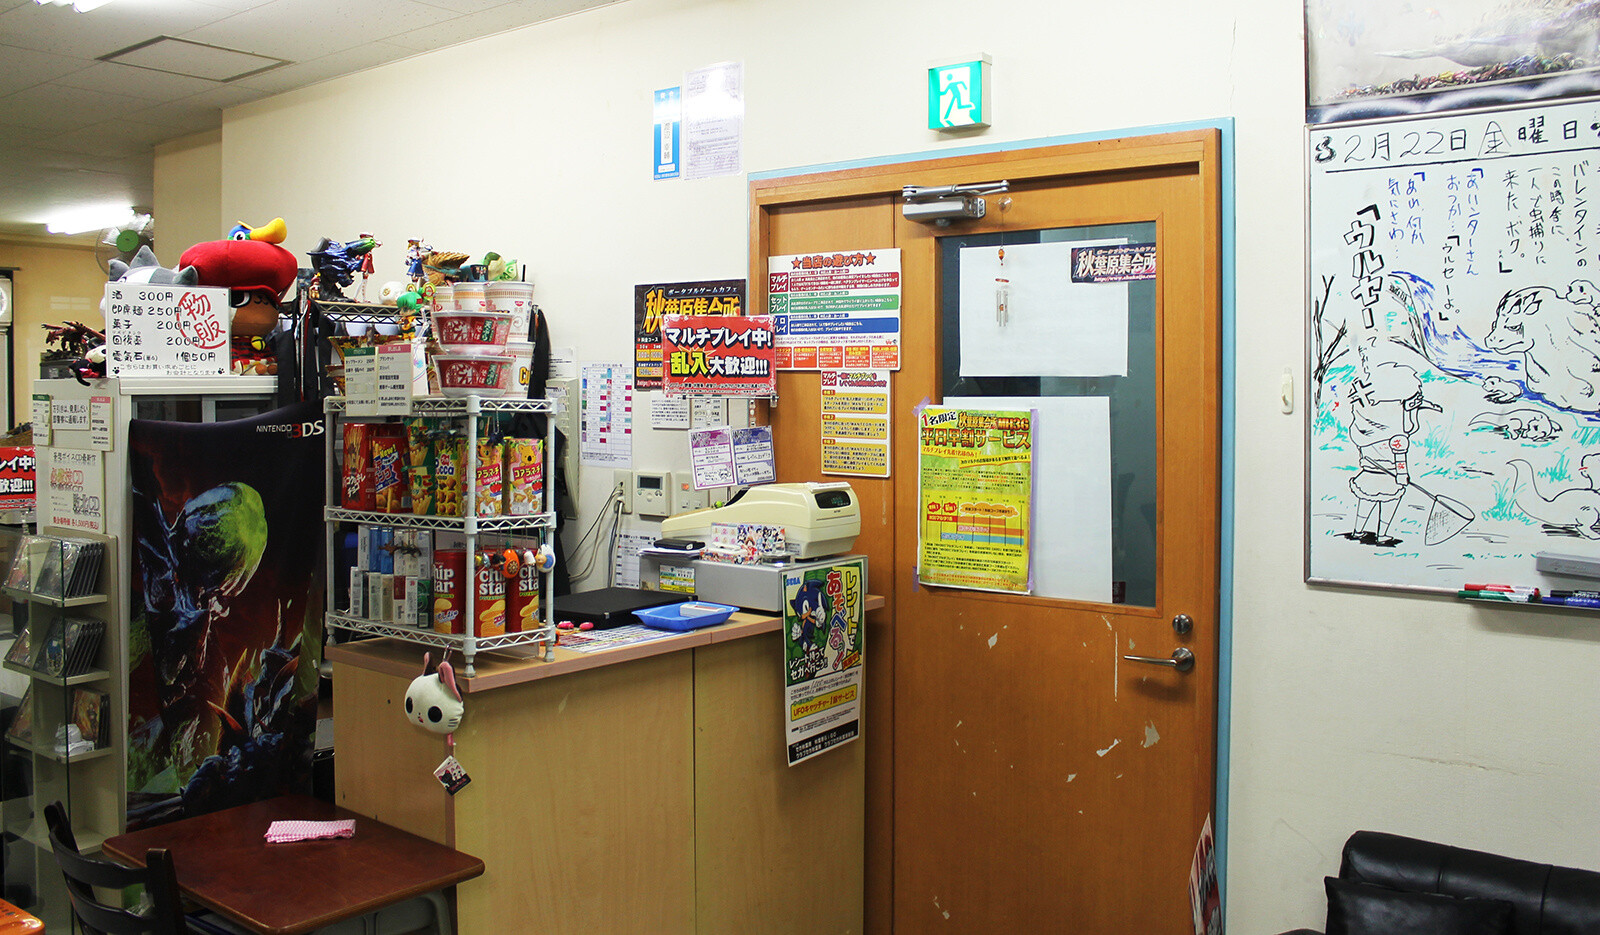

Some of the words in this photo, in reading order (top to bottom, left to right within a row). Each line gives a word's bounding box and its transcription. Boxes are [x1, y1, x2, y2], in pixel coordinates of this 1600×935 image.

[770, 274, 788, 283] マルチ
[770, 282, 788, 292] プレイ
[138, 291, 174, 303] 300円
[770, 295, 788, 304] セット
[147, 306, 182, 317] 250円
[770, 304, 787, 313] プレイ
[156, 320, 191, 331] 200円
[166, 337, 200, 348] 200円
[256, 424, 293, 433] NINTENDO
[292, 420, 325, 438] 3DS
[921, 428, 1031, 450] 平日早割サービス
[786, 577, 801, 586] SEGA
